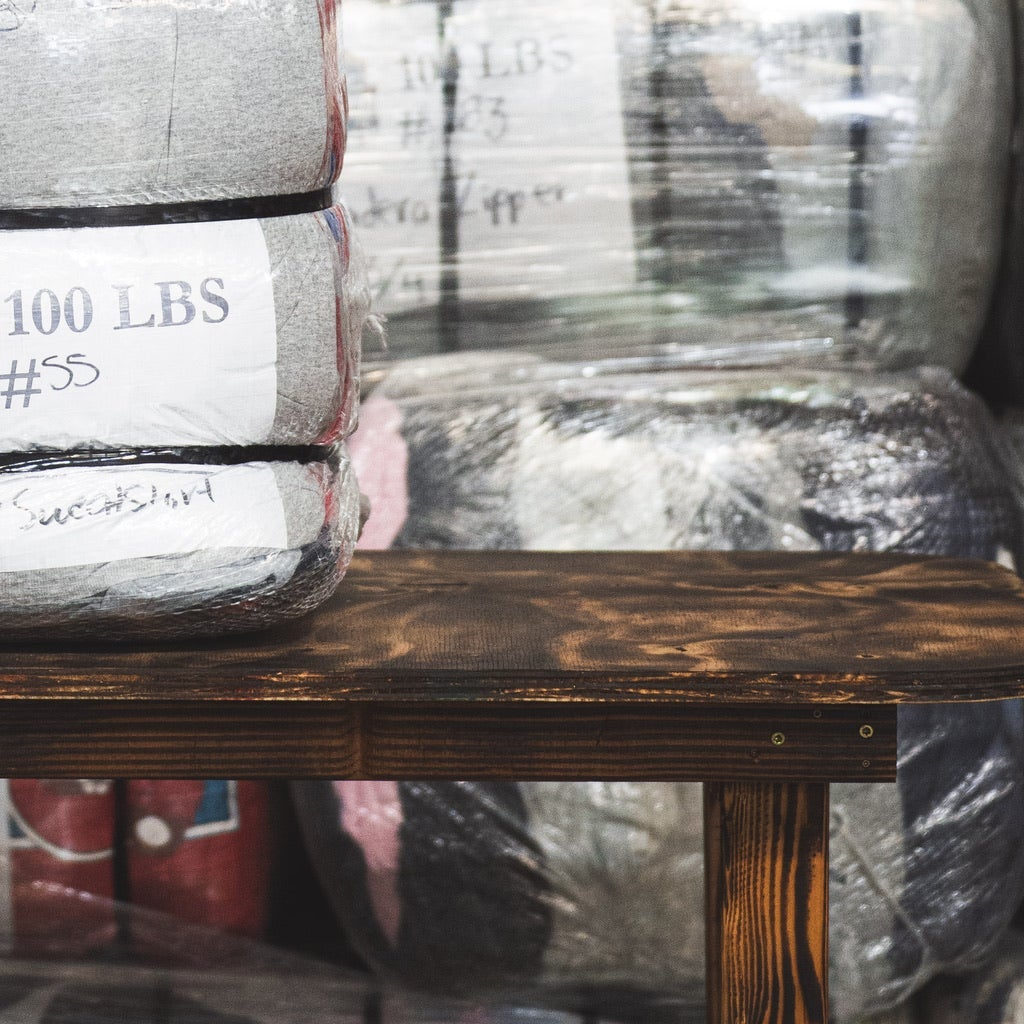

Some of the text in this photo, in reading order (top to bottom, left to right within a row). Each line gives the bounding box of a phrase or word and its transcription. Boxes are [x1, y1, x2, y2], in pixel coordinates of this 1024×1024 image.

[479, 32, 575, 79] LBS
[4, 277, 231, 337] 100 LBS
